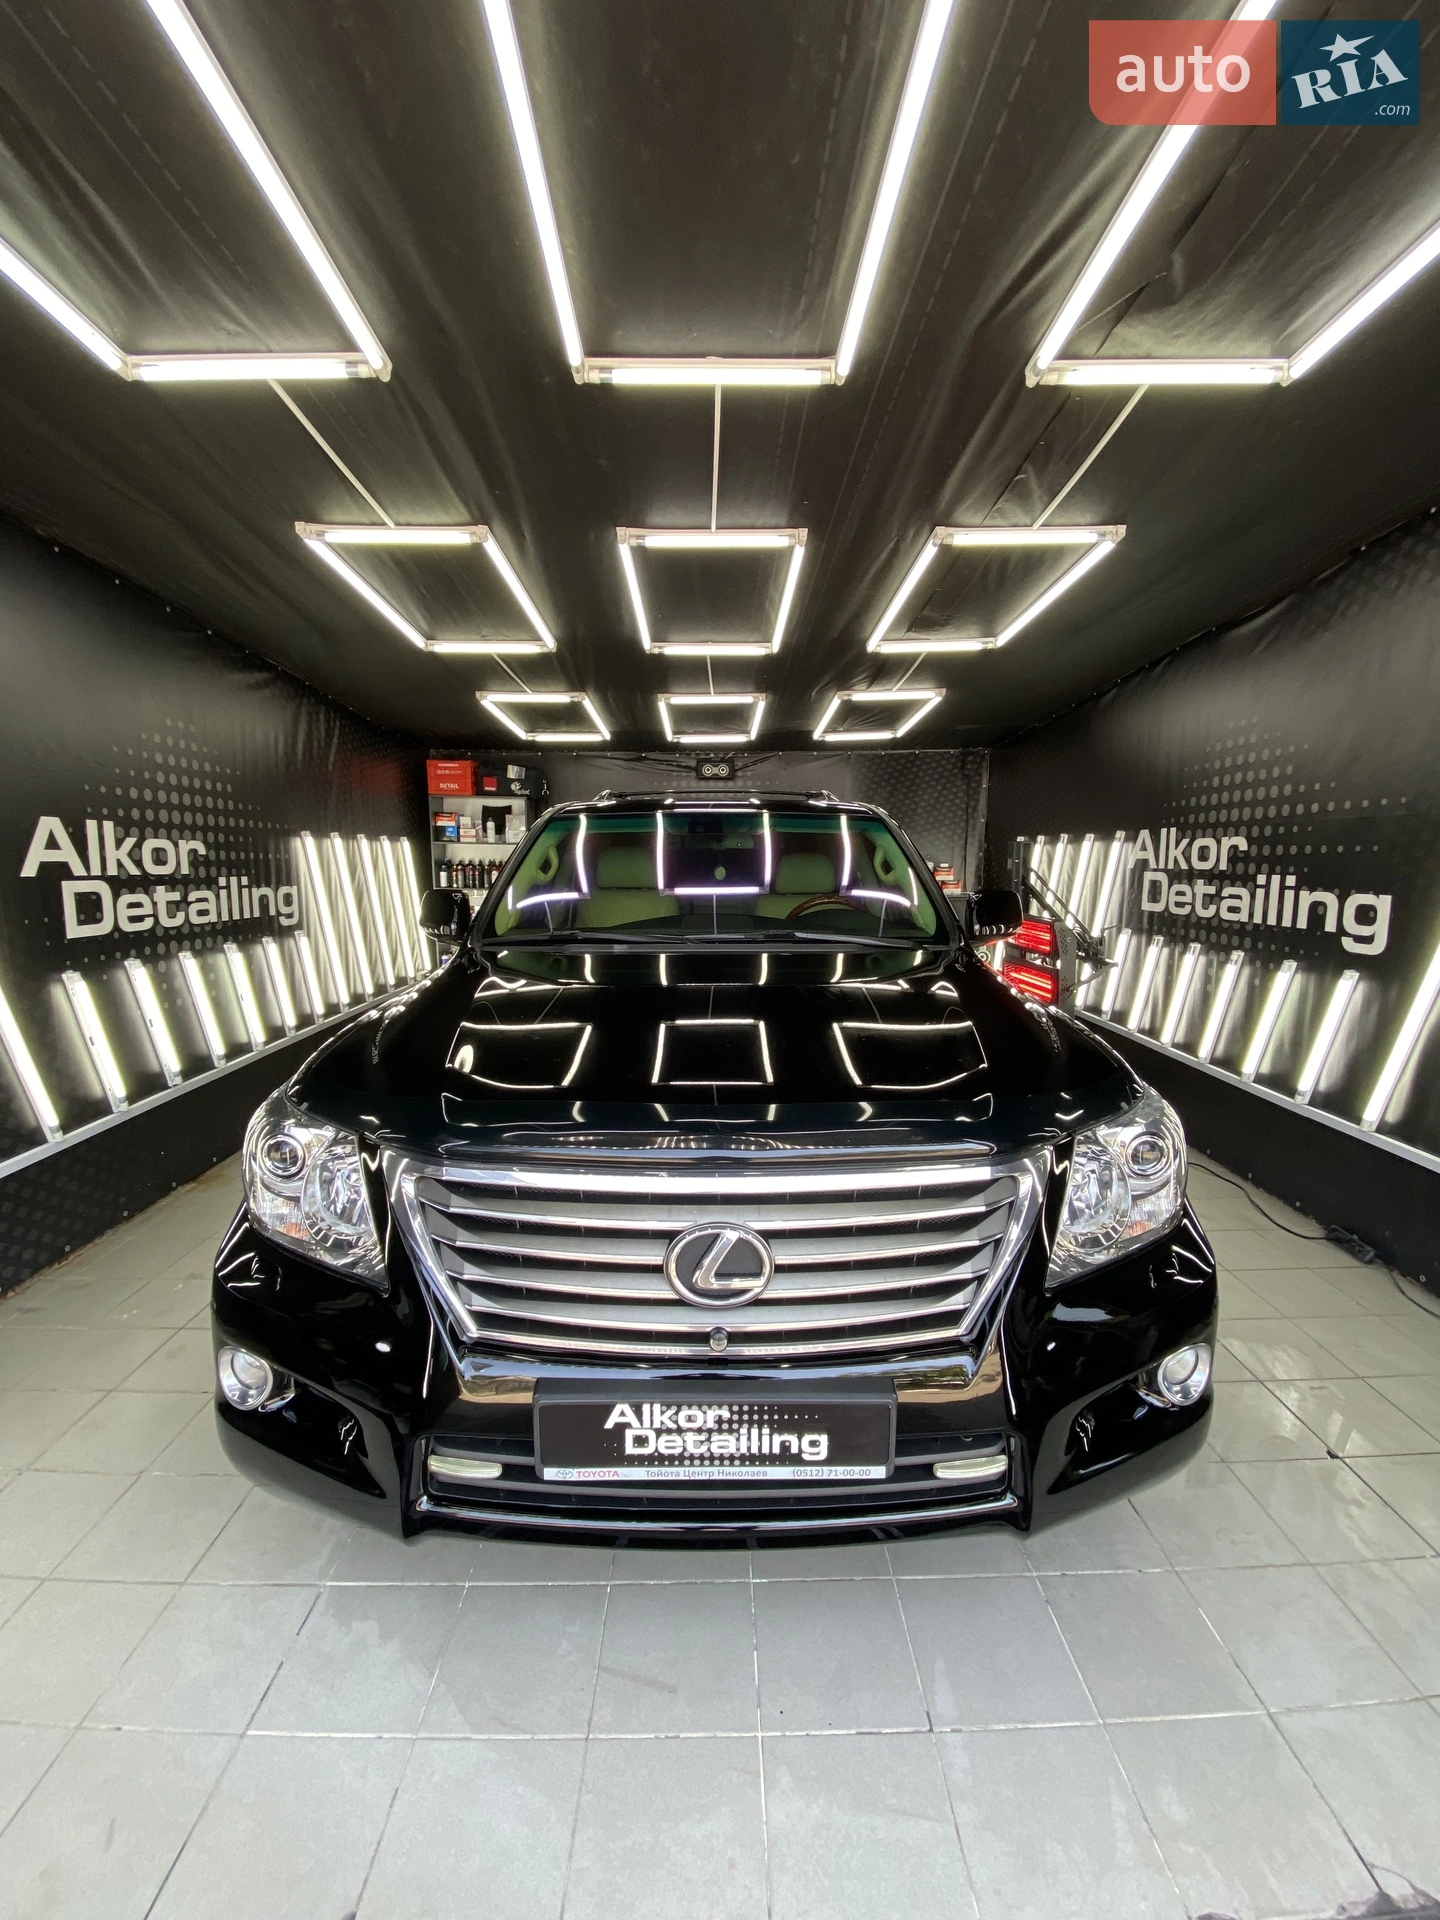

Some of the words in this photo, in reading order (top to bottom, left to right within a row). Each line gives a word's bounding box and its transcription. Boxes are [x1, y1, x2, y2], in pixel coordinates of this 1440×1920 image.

[20, 816, 207, 877] Alkor
[1128, 827, 1248, 871] Alkor
[61, 876, 299, 939] Detailing
[1141, 871, 1392, 956] Detailing
[604, 1403, 731, 1429] Alkor
[625, 1428, 829, 1461] Detailing
[576, 1470, 620, 1478] TOYOTA
[645, 1469, 680, 1478] Тойота
[683, 1469, 715, 1480] Центр
[717, 1468, 768, 1478] Николаев
[792, 1468, 824, 1478] (0512)
[827, 1468, 871, 1477] 71-00-00
